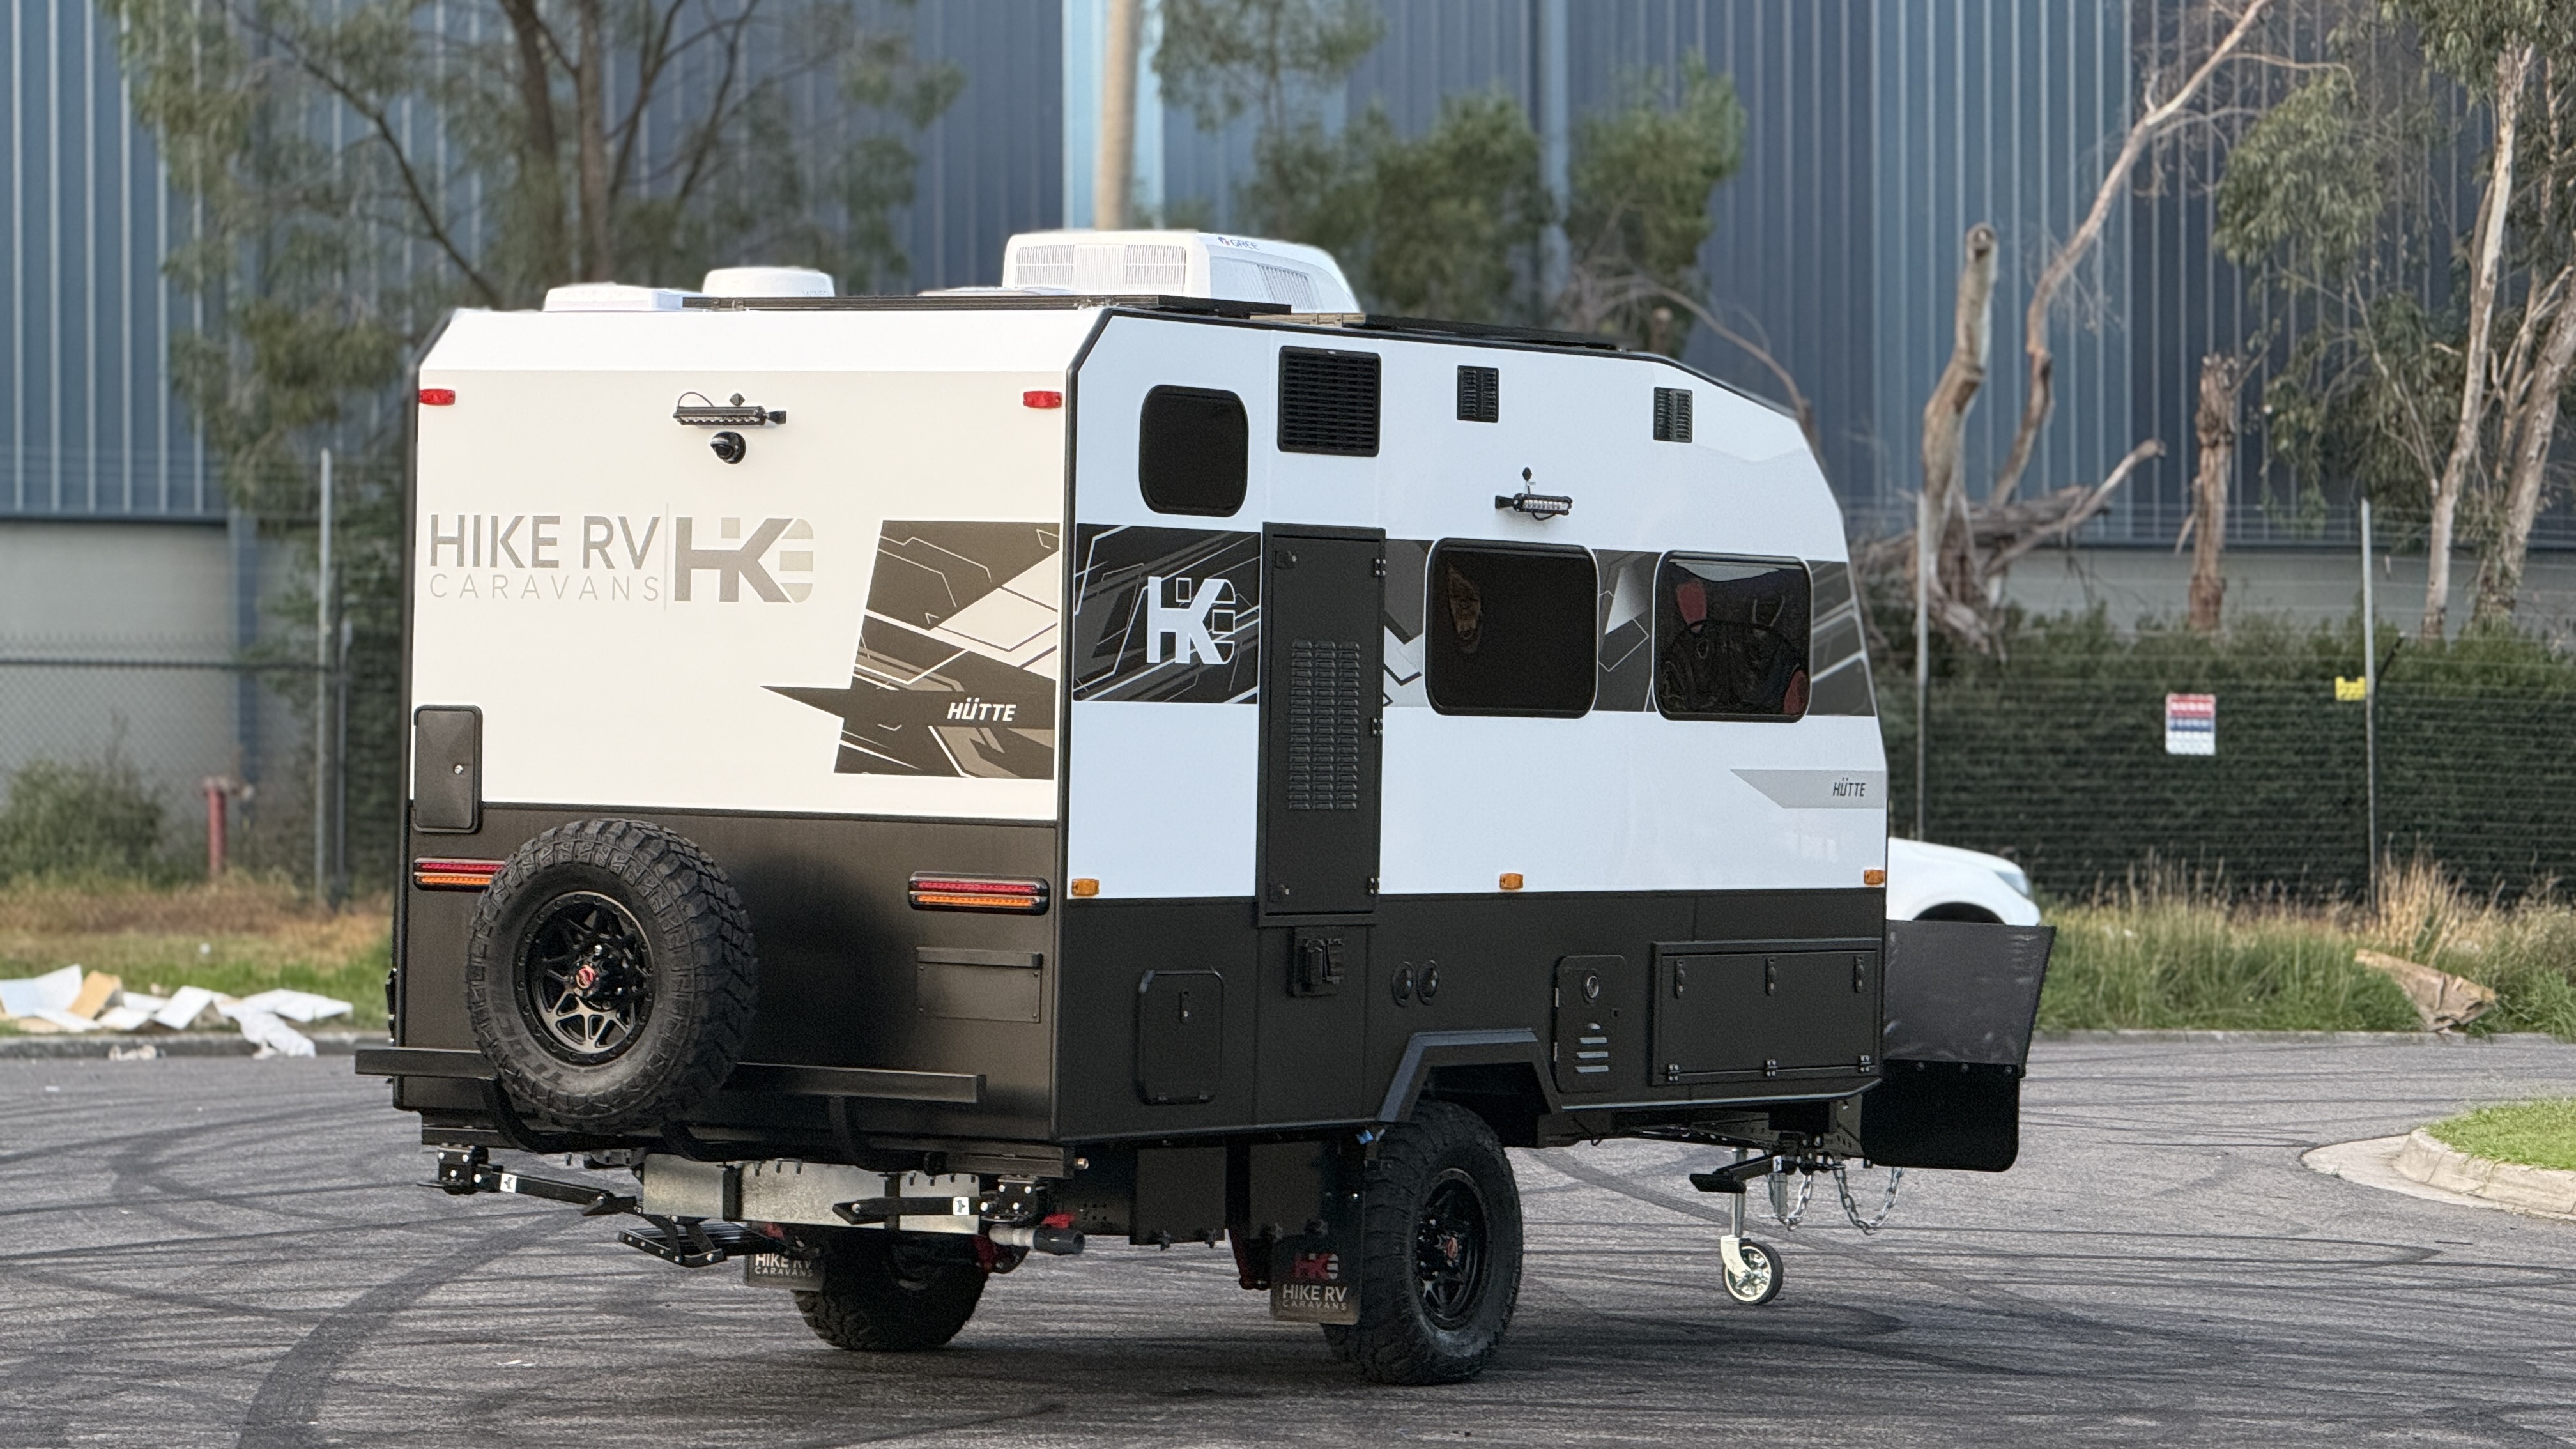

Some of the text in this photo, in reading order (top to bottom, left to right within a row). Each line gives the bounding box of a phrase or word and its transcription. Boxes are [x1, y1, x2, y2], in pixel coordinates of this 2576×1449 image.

[1230, 239, 1260, 250] GREE
[430, 514, 661, 570] HIKE RV
[429, 573, 659, 602] CARAVANS
[947, 697, 1017, 722] HÜTTE
[1832, 777, 1866, 797] HÜTTE
[755, 1253, 789, 1268] HIKE
[755, 1266, 814, 1278] CARAVANS
[1282, 1284, 1347, 1303] HIKE RV
[1282, 1299, 1347, 1311] CARAVANS
